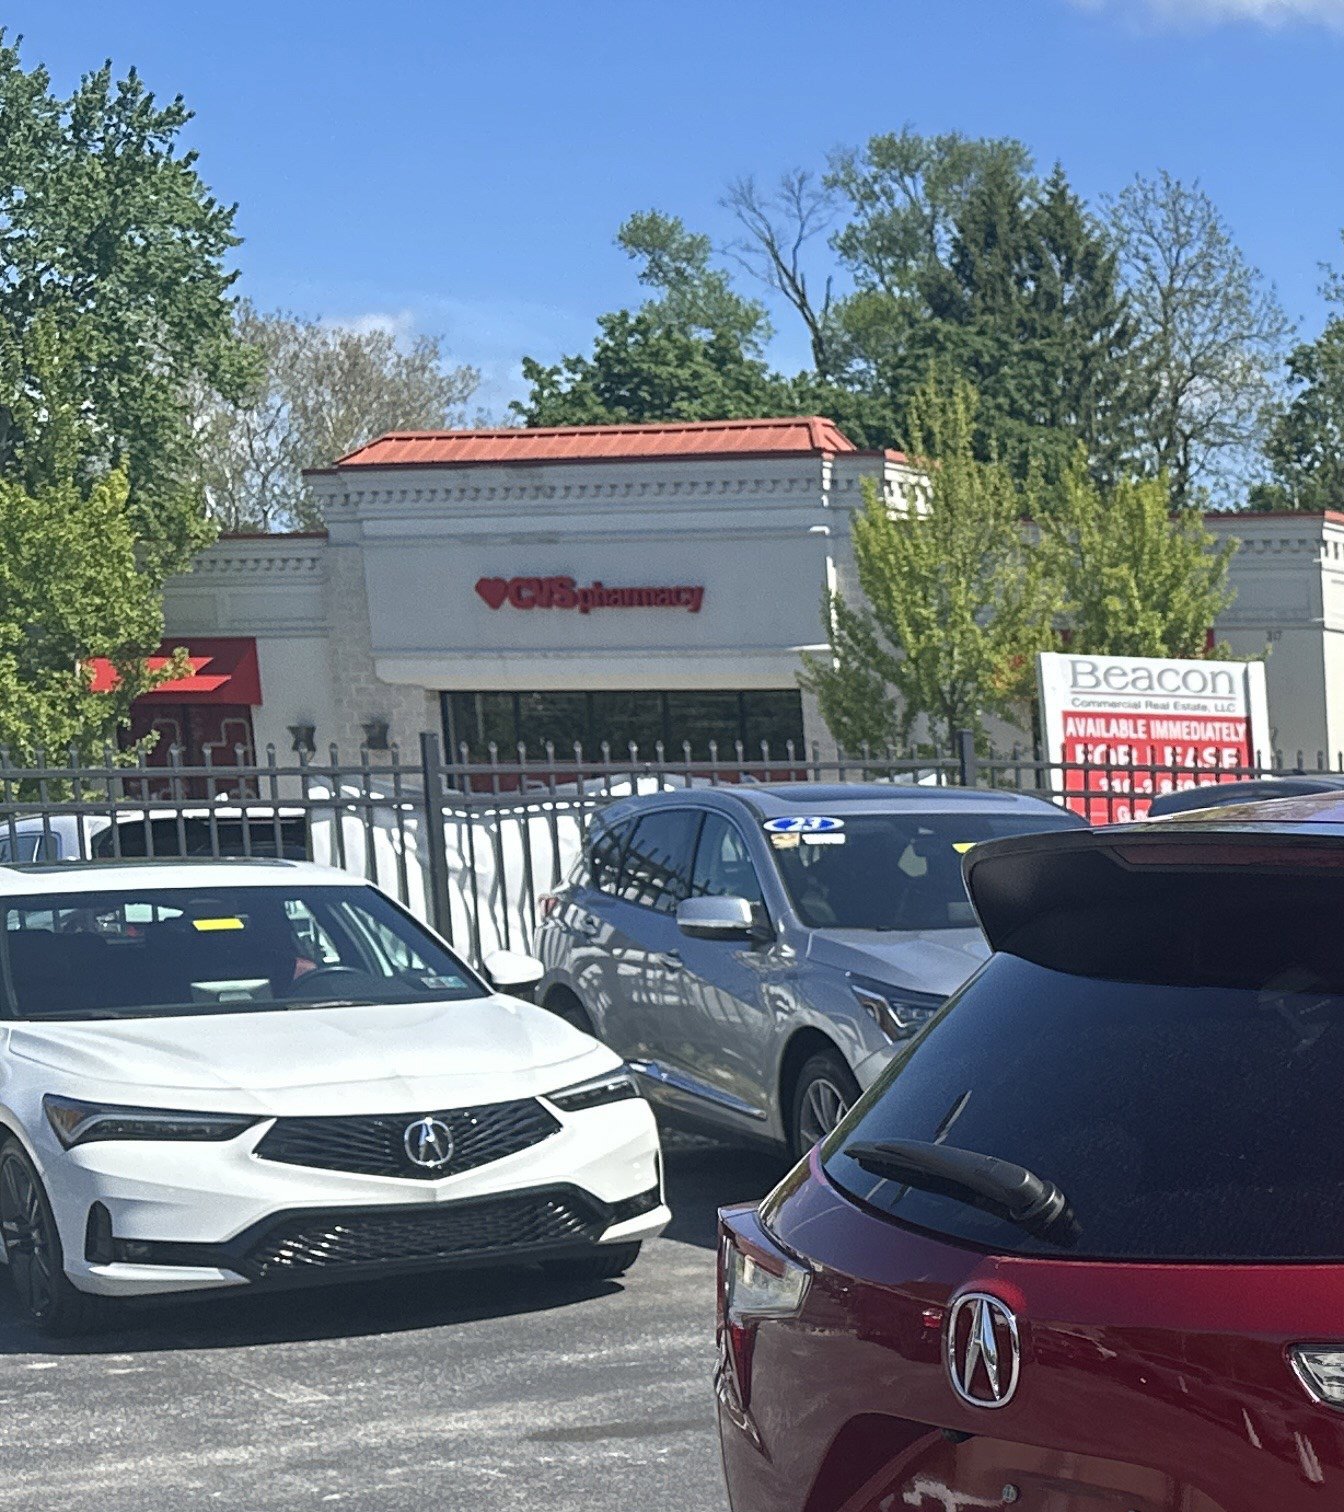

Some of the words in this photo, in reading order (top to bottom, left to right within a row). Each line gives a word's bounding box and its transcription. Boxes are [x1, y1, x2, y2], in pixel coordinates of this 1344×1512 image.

[508, 576, 578, 610] CVS
[578, 581, 704, 614] pharmacy
[1070, 660, 1236, 694] Beacon
[1071, 697, 1142, 711] Commercial
[1145, 700, 1170, 711] Real
[1214, 703, 1236, 713] LLC
[1066, 716, 1147, 739] AVAILABLE
[1150, 721, 1246, 743] IMMEDIATELY
